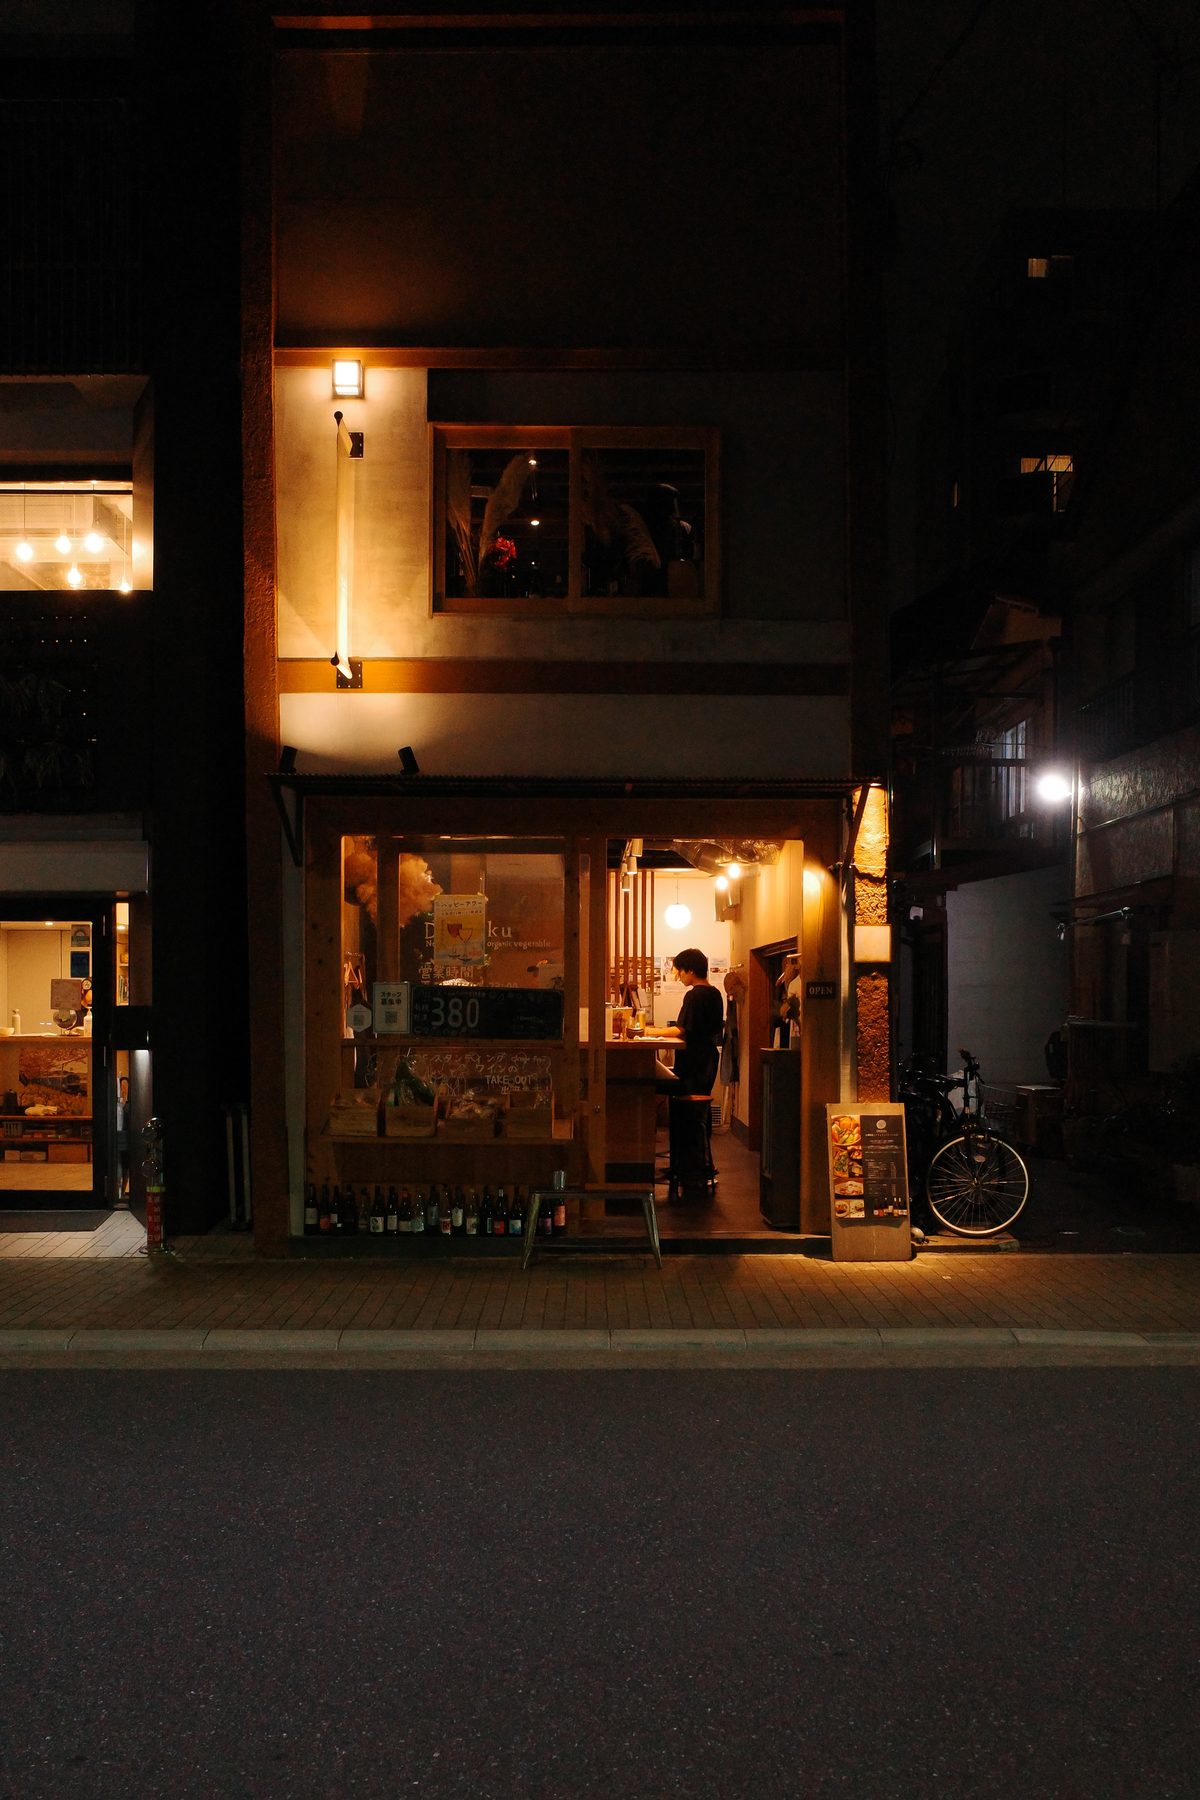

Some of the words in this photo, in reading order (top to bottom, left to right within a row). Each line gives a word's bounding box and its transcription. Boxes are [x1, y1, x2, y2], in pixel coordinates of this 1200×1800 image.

[486, 940, 512, 951] organic
[513, 938, 551, 950] vegetable
[418, 961, 474, 980] 営業時間
[809, 986, 833, 995] OPEN
[431, 997, 480, 1029] 380
[475, 1064, 518, 1074] ワインの
[485, 1075, 510, 1085] TAKE
[514, 1075, 532, 1085] OUT
